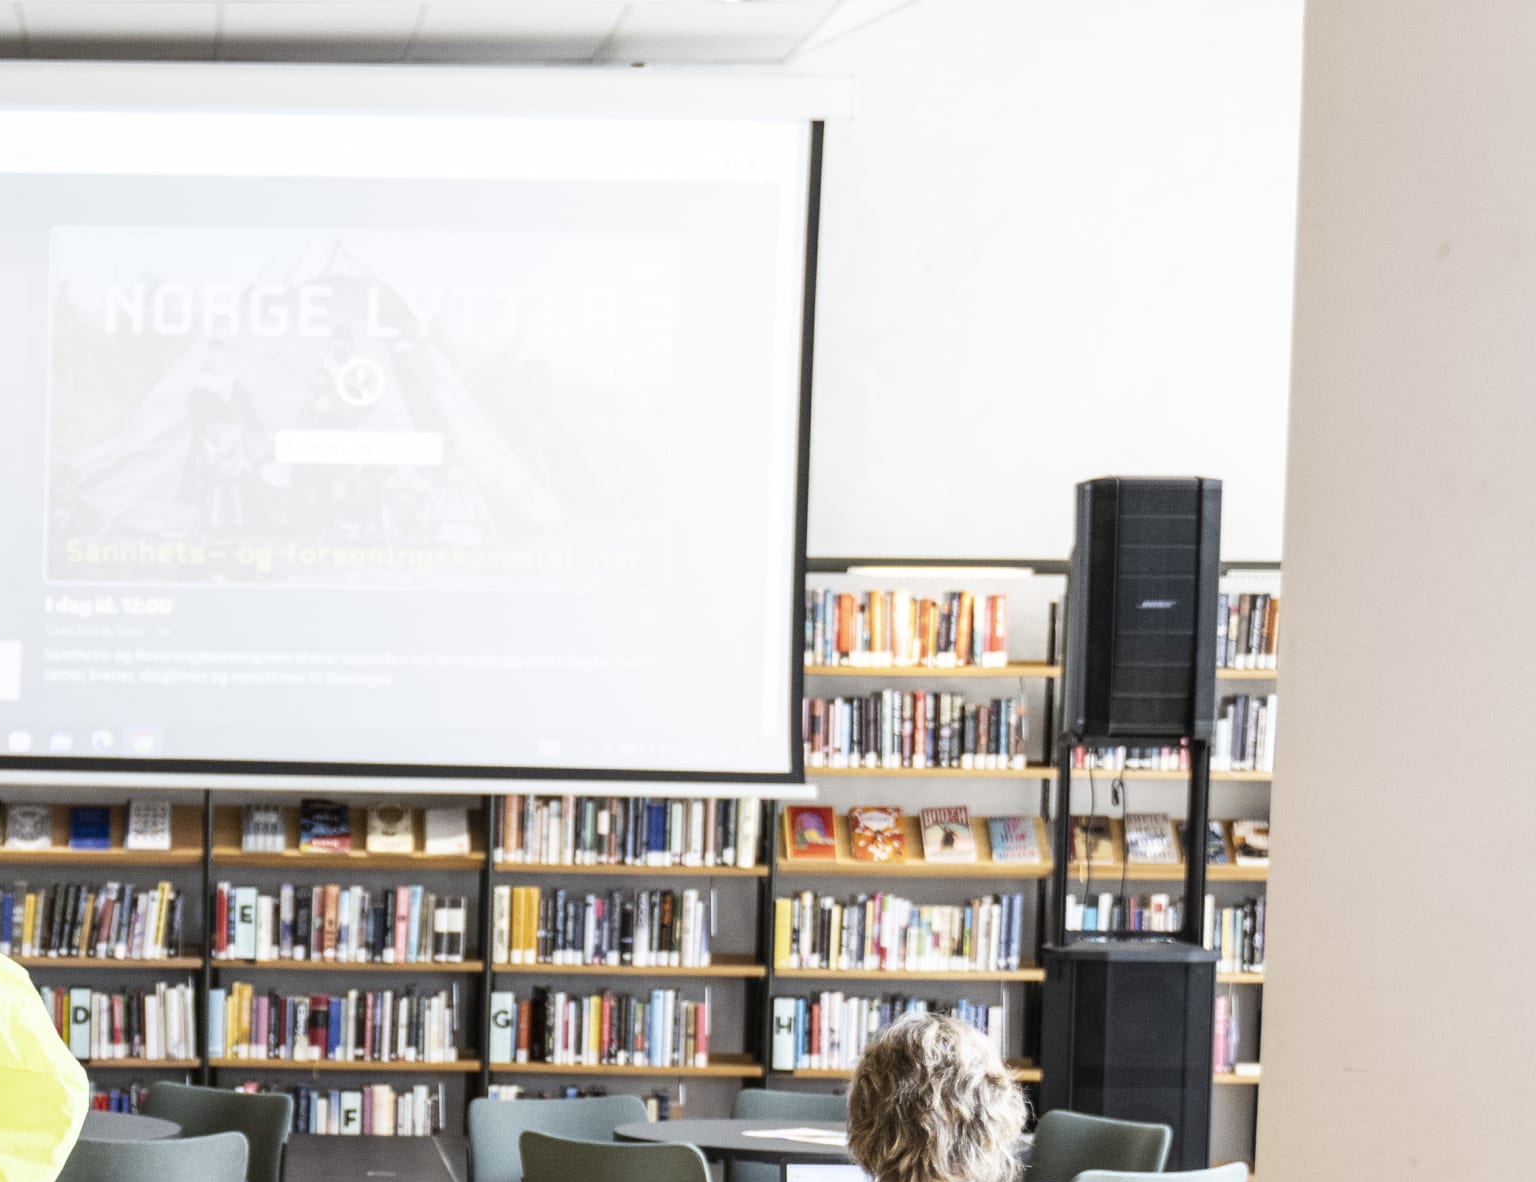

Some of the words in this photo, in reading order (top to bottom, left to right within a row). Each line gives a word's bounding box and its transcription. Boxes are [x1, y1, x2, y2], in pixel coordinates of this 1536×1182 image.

[104, 282, 334, 338] NORGE
[65, 539, 224, 567] Sannhets-
[236, 543, 275, 575] og
[55, 596, 91, 616] dag
[120, 597, 172, 614] 12:00
[239, 904, 253, 924] E
[72, 1006, 90, 1025] D
[492, 1010, 512, 1028] G
[775, 1014, 793, 1034] H
[343, 1107, 357, 1127] F
